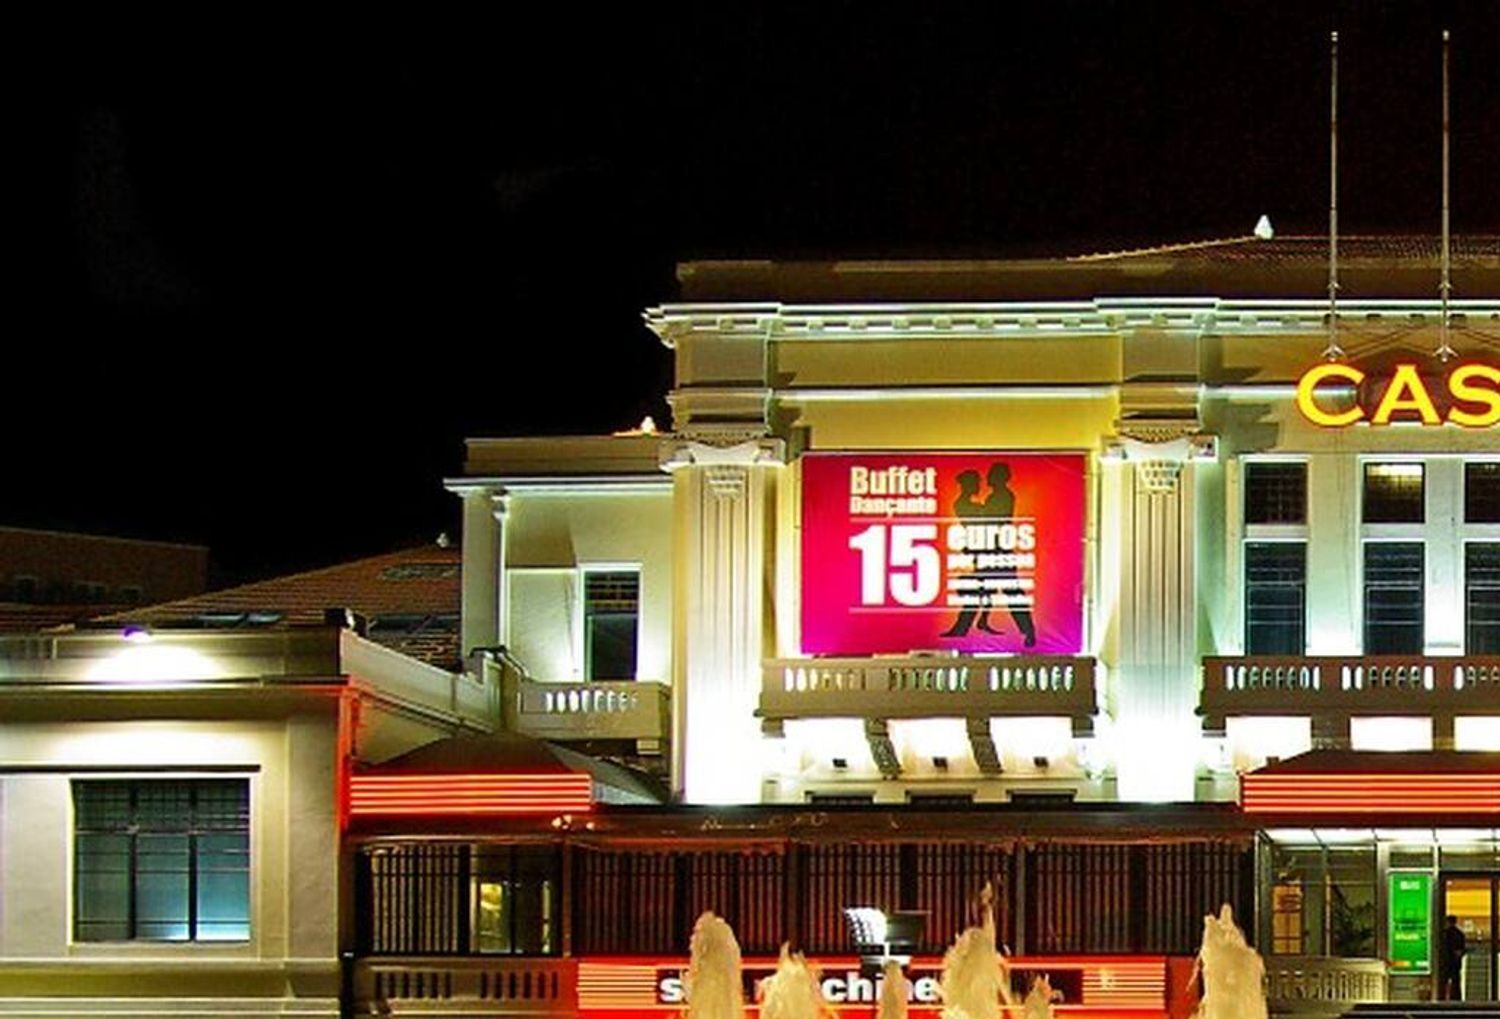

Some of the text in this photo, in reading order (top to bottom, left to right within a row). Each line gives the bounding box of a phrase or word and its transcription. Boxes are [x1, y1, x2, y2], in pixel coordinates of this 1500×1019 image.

[851, 466, 938, 495] Buffet
[947, 524, 1036, 550] euros
[849, 524, 941, 606] 15
